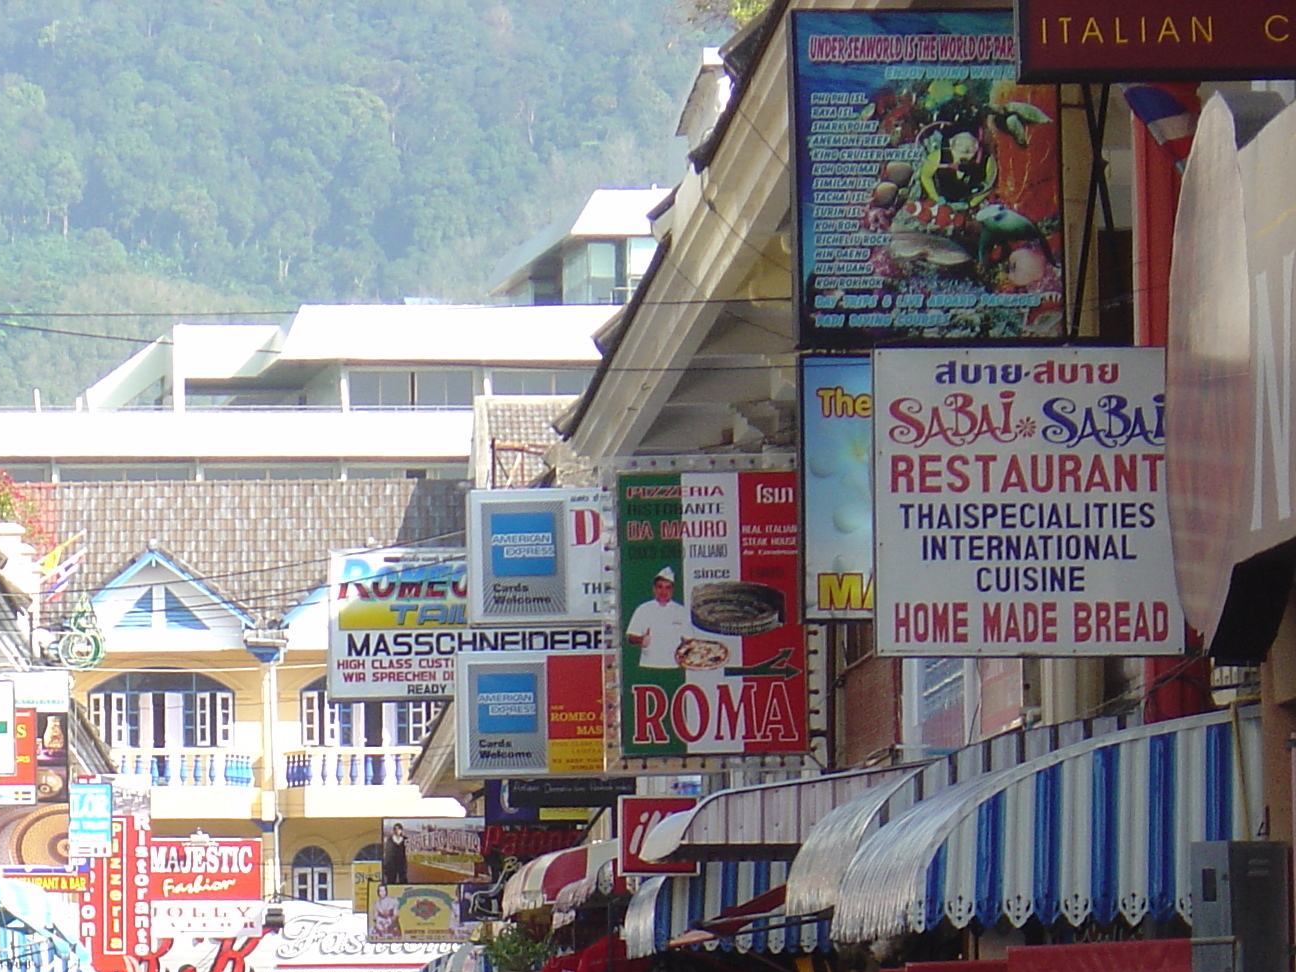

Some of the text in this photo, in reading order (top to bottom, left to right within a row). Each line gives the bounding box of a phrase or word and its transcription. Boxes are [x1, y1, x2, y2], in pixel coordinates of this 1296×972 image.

[1041, 16, 1214, 44] ITALIAN
[809, 35, 846, 60] UNDER
[903, 34, 917, 60] IS
[917, 34, 938, 60] THE
[940, 34, 976, 60] WORLD
[977, 34, 992, 60] OF
[885, 66, 925, 79] ENJOY
[926, 66, 968, 79] DIVING
[811, 93, 849, 104] PHI PHI
[811, 121, 879, 132] SHARK POINT
[812, 135, 891, 146] ANEMONE REEF
[812, 149, 920, 160] KING CRUISER WRECK
[812, 164, 880, 175] KOH MAI
[813, 178, 856, 189] SIMILAN
[814, 192, 850, 203] TACHAI
[814, 206, 846, 217] SURIN
[814, 220, 837, 231] KOH
[863, 235, 890, 246] ROCK
[815, 249, 871, 260] HIN DAENG
[815, 263, 873, 274] HIN MUANG
[815, 277, 838, 288] KOH
[842, 294, 878, 308] TRIPS
[895, 294, 924, 308] LIVE
[927, 294, 977, 308] ABOARD
[980, 293, 1043, 307] PACKAGES
[815, 313, 952, 327] PADI DIVING COURSES
[816, 387, 872, 419] The
[890, 453, 1165, 493] RESTAURANT
[626, 485, 724, 498] PIZZERIA
[627, 503, 724, 516] RISTORANTE
[627, 520, 728, 540] DA MAURO
[742, 524, 798, 534] REAL ITALIAN
[491, 534, 551, 544] AMERICAN
[742, 537, 796, 546] STEAK HOUSE
[504, 547, 555, 557] EXPRESS
[689, 544, 728, 558] ITALIANO
[921, 535, 1138, 561] INTERNATIONAL
[693, 567, 730, 580] since
[975, 567, 1086, 592] CUISINE
[492, 583, 529, 594] Cards
[492, 594, 552, 605] Welcome
[893, 601, 1169, 643] HOME MADE BREAD
[337, 659, 454, 670] HIGH CLASS CUST
[343, 672, 437, 682] WIR SPRECHEN
[407, 684, 447, 694] READY
[478, 693, 533, 703] AMERICAN
[489, 705, 537, 715] EXPRESS
[632, 682, 799, 744] ROMA
[550, 712, 596, 722] ROMEO
[478, 740, 512, 750] Cards
[478, 750, 533, 761] Welcome
[150, 845, 253, 874] MAJESTIC
[69, 877, 87, 891] BAR
[108, 823, 124, 949] Pizzeria
[133, 813, 152, 956] Ristorante
[162, 875, 237, 898] Fashion
[151, 906, 253, 919] JOLLY
